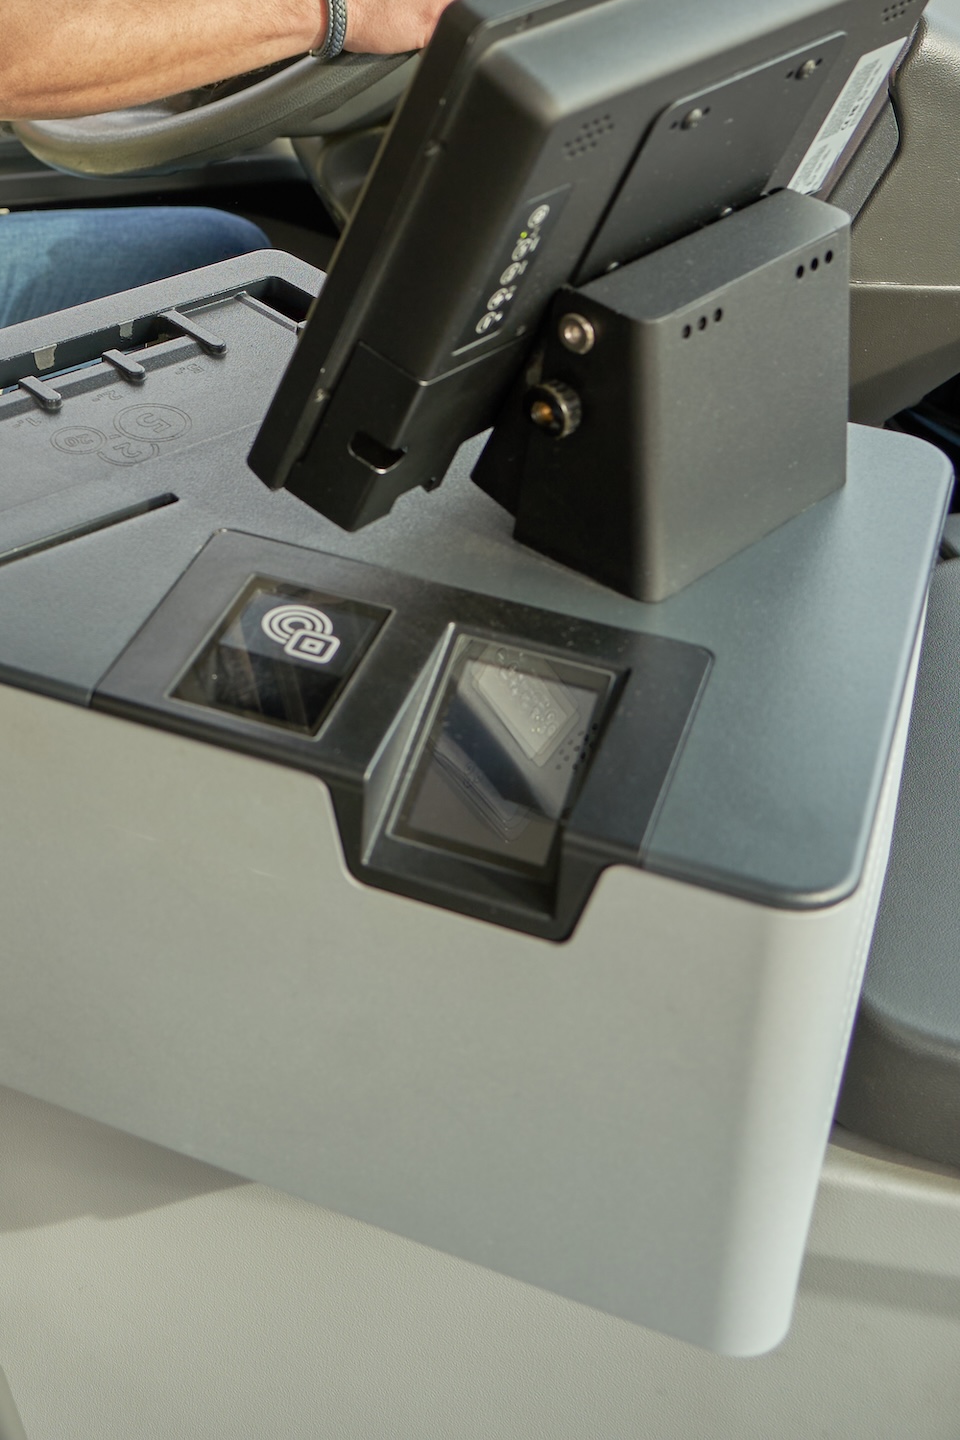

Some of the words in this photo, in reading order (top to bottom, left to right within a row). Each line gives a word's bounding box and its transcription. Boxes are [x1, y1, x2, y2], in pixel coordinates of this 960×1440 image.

[136, 412, 171, 433] 5
[64, 433, 94, 448] 20
[112, 442, 142, 459] 2
